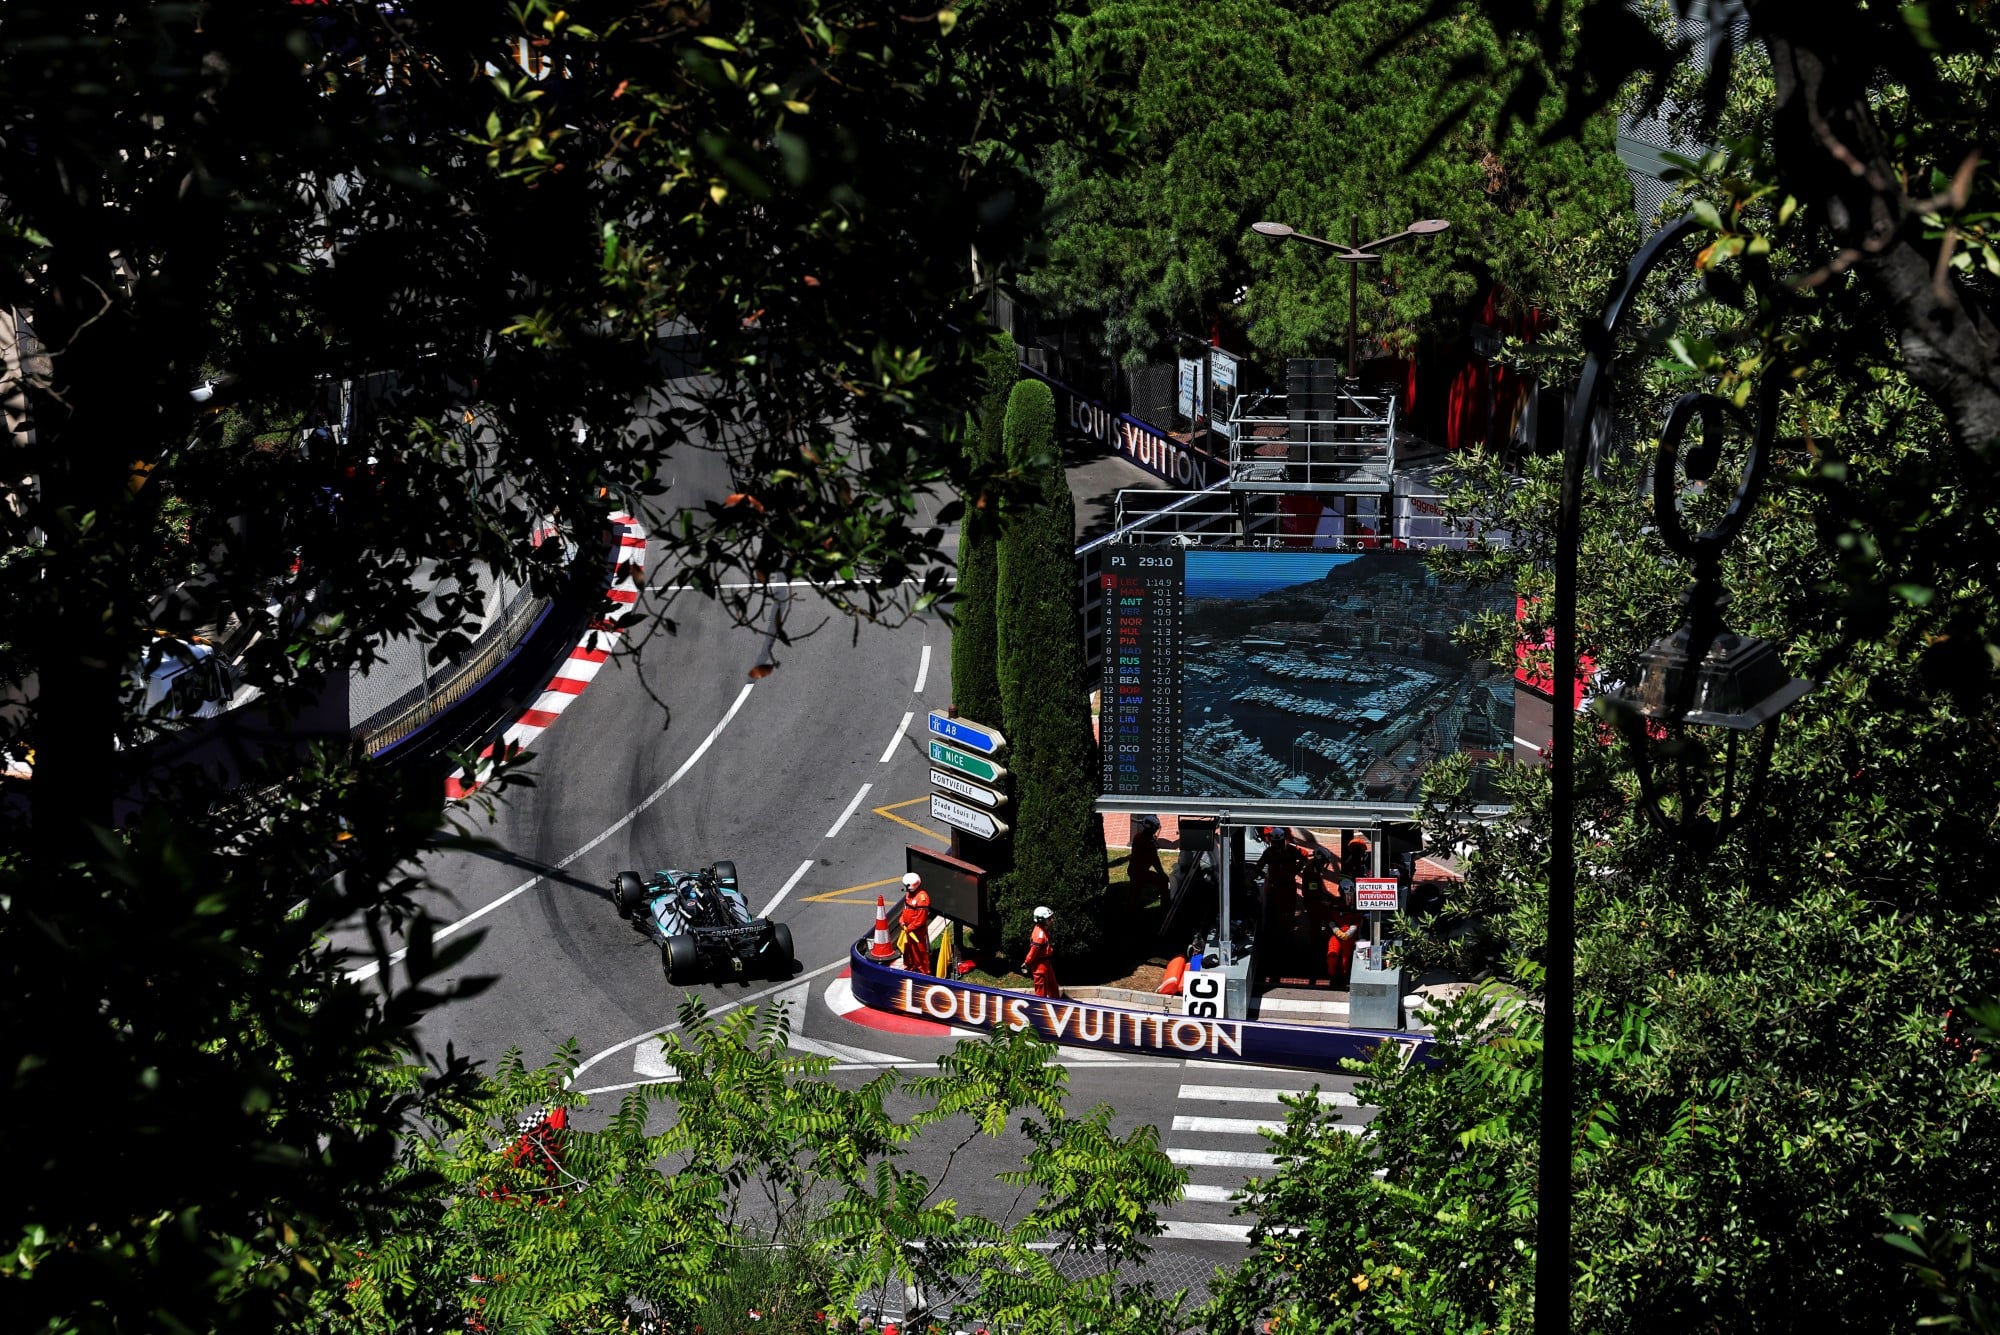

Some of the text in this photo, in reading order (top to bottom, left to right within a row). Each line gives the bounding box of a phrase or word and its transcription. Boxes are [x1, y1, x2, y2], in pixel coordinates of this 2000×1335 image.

[1070, 395, 1206, 490] LOUIS VUITTON
[1112, 556, 1174, 566] P1 29:10
[1153, 618, 1171, 626] +1.0
[1152, 667, 1170, 675] +1.7
[1152, 706, 1170, 714] +2.3
[946, 724, 956, 736] A8
[946, 752, 964, 766] NICE
[1152, 755, 1170, 763] +2.7
[933, 774, 973, 795] FONTVIEILLE
[934, 799, 950, 810] Stade
[954, 806, 968, 818] Louis
[906, 979, 1242, 1056] LOUIS VUITTON
